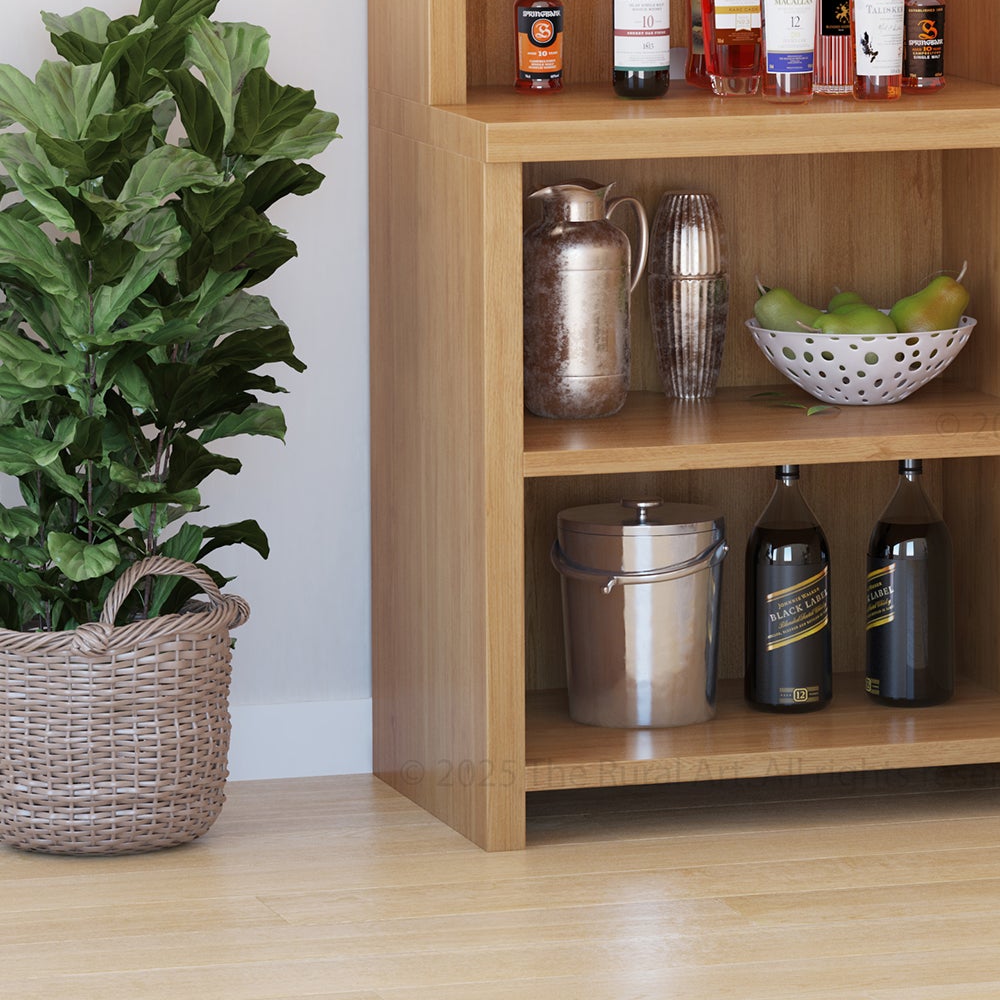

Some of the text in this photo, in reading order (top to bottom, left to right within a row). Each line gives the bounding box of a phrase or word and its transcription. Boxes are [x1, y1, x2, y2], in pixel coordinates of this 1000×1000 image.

[866, 4, 902, 14] TALISKE
[643, 16, 654, 28] 10
[791, 16, 800, 27] 12
[870, 585, 894, 600] LABEL
[769, 604, 803, 622] BLACK
[796, 691, 805, 699] 12
